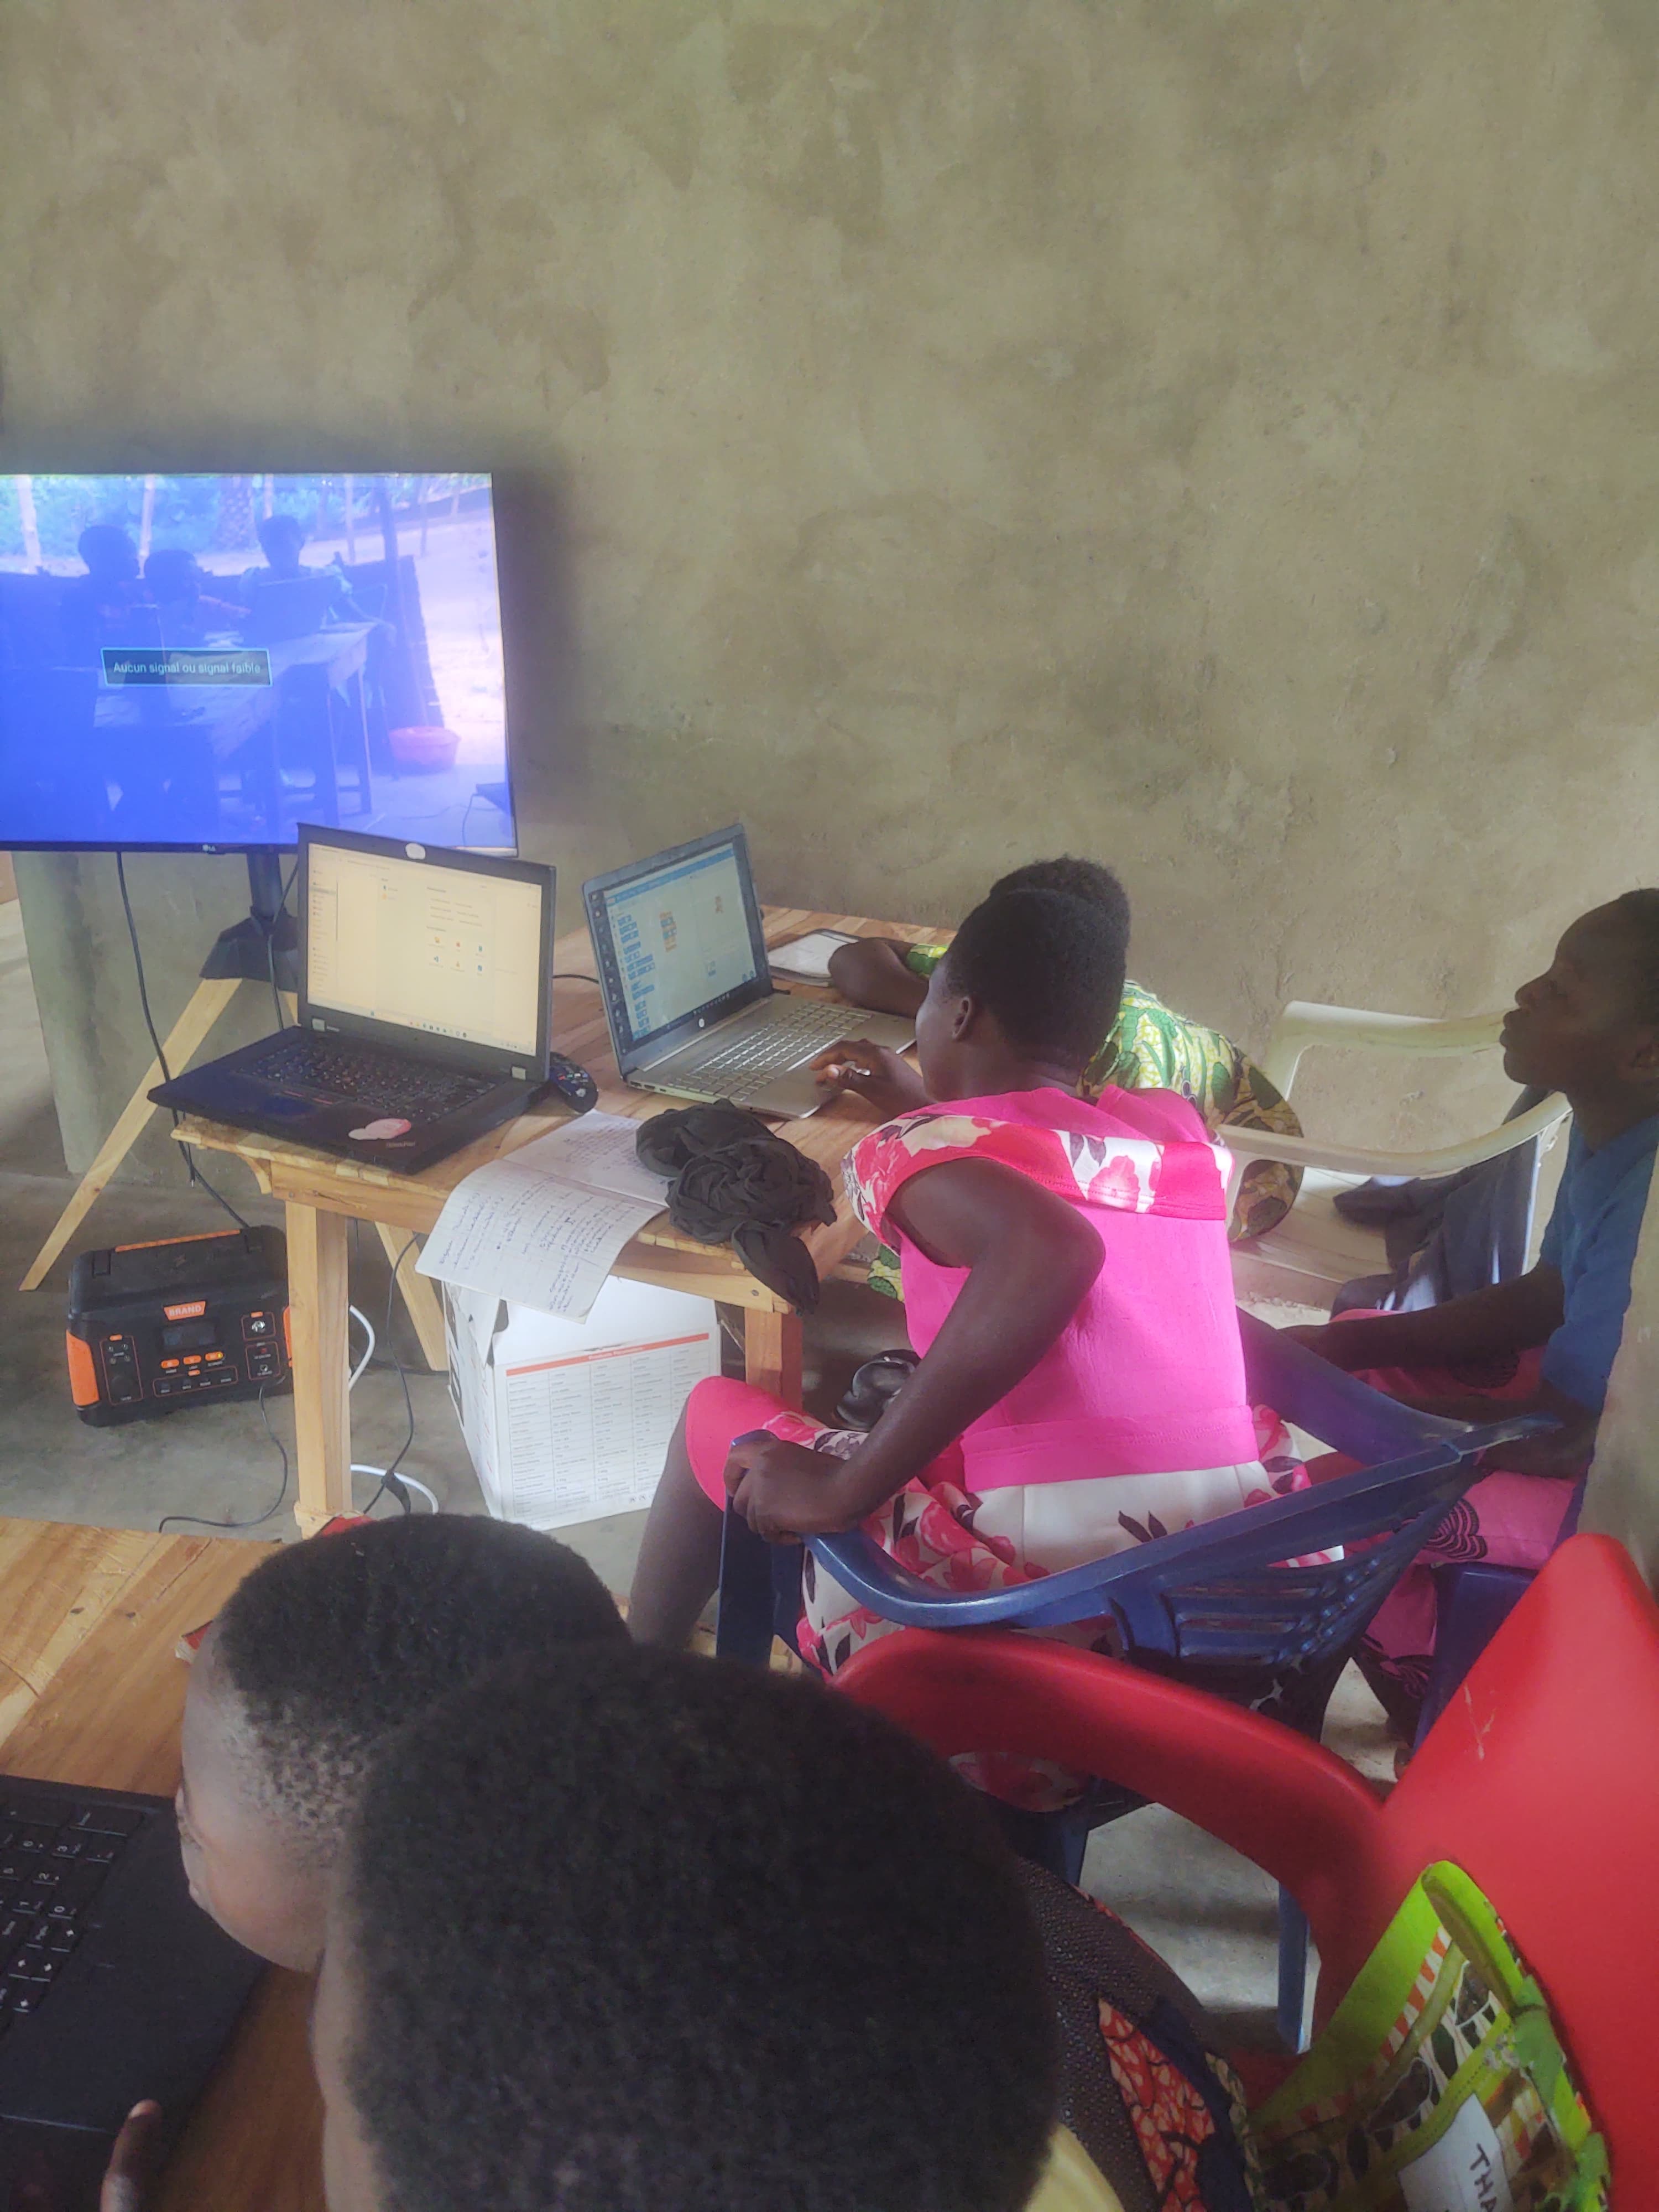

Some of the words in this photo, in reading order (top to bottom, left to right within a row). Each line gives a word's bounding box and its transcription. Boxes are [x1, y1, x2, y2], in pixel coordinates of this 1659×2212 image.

[113, 662, 147, 673] Aucun
[149, 662, 179, 675] signal
[182, 664, 196, 674] ou
[198, 662, 229, 676] signal
[231, 662, 260, 674] faible
[169, 1304, 202, 1316] BRAND
